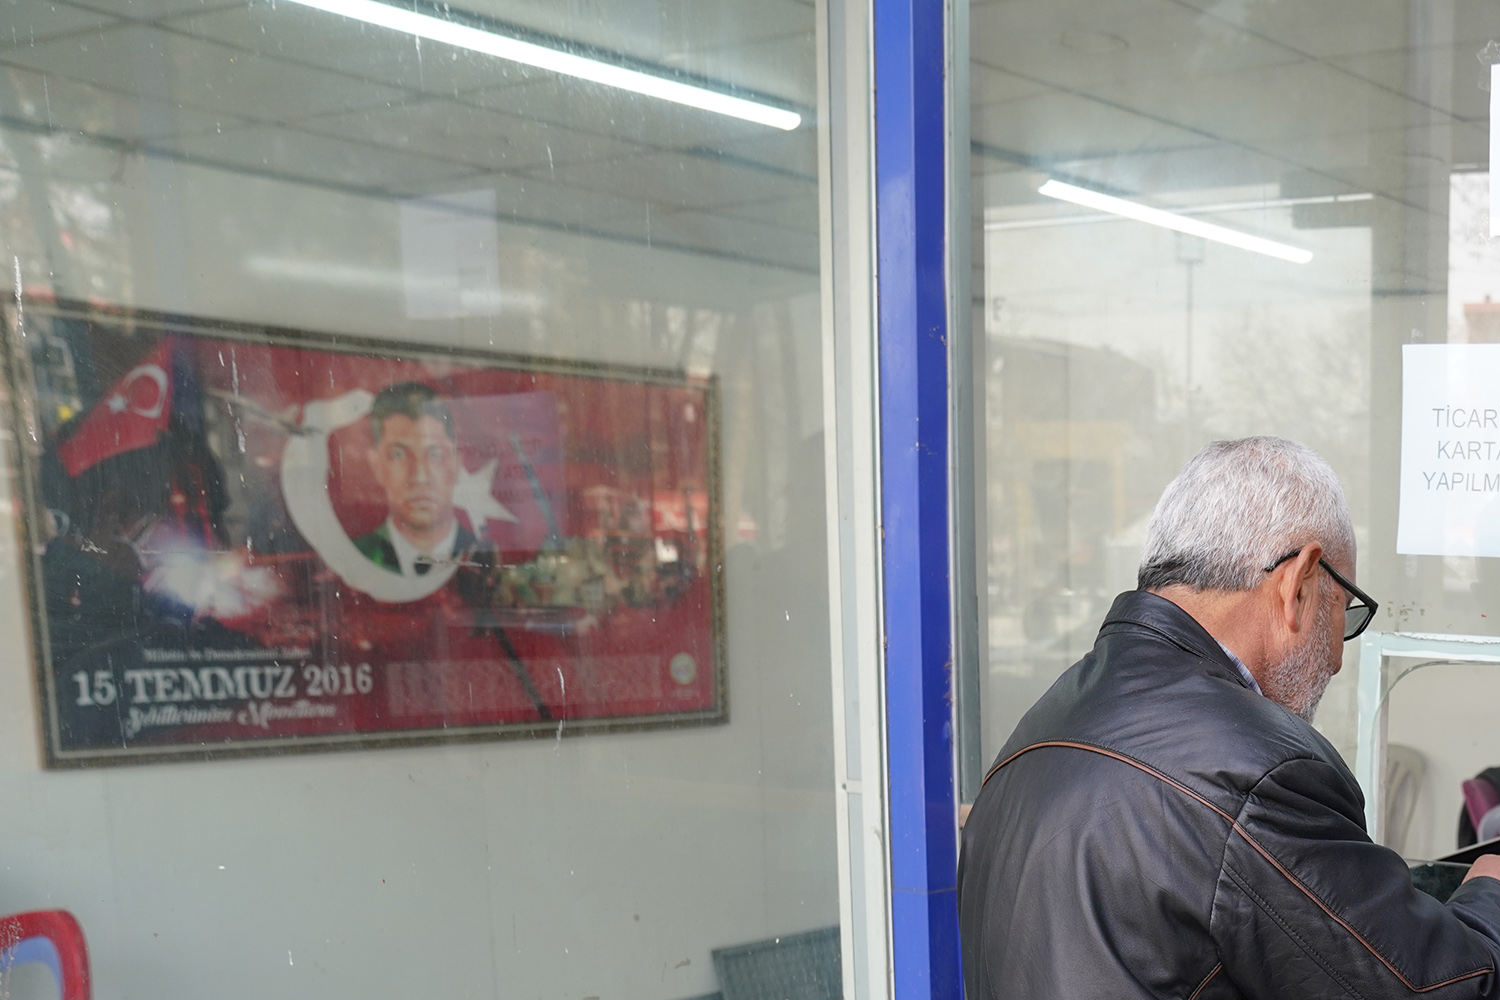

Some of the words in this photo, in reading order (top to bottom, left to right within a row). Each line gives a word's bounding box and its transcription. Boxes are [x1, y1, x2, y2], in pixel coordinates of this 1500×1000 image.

[72, 669, 117, 706] 15
[124, 665, 297, 704] TEMMUZ
[303, 663, 373, 697] 2016
